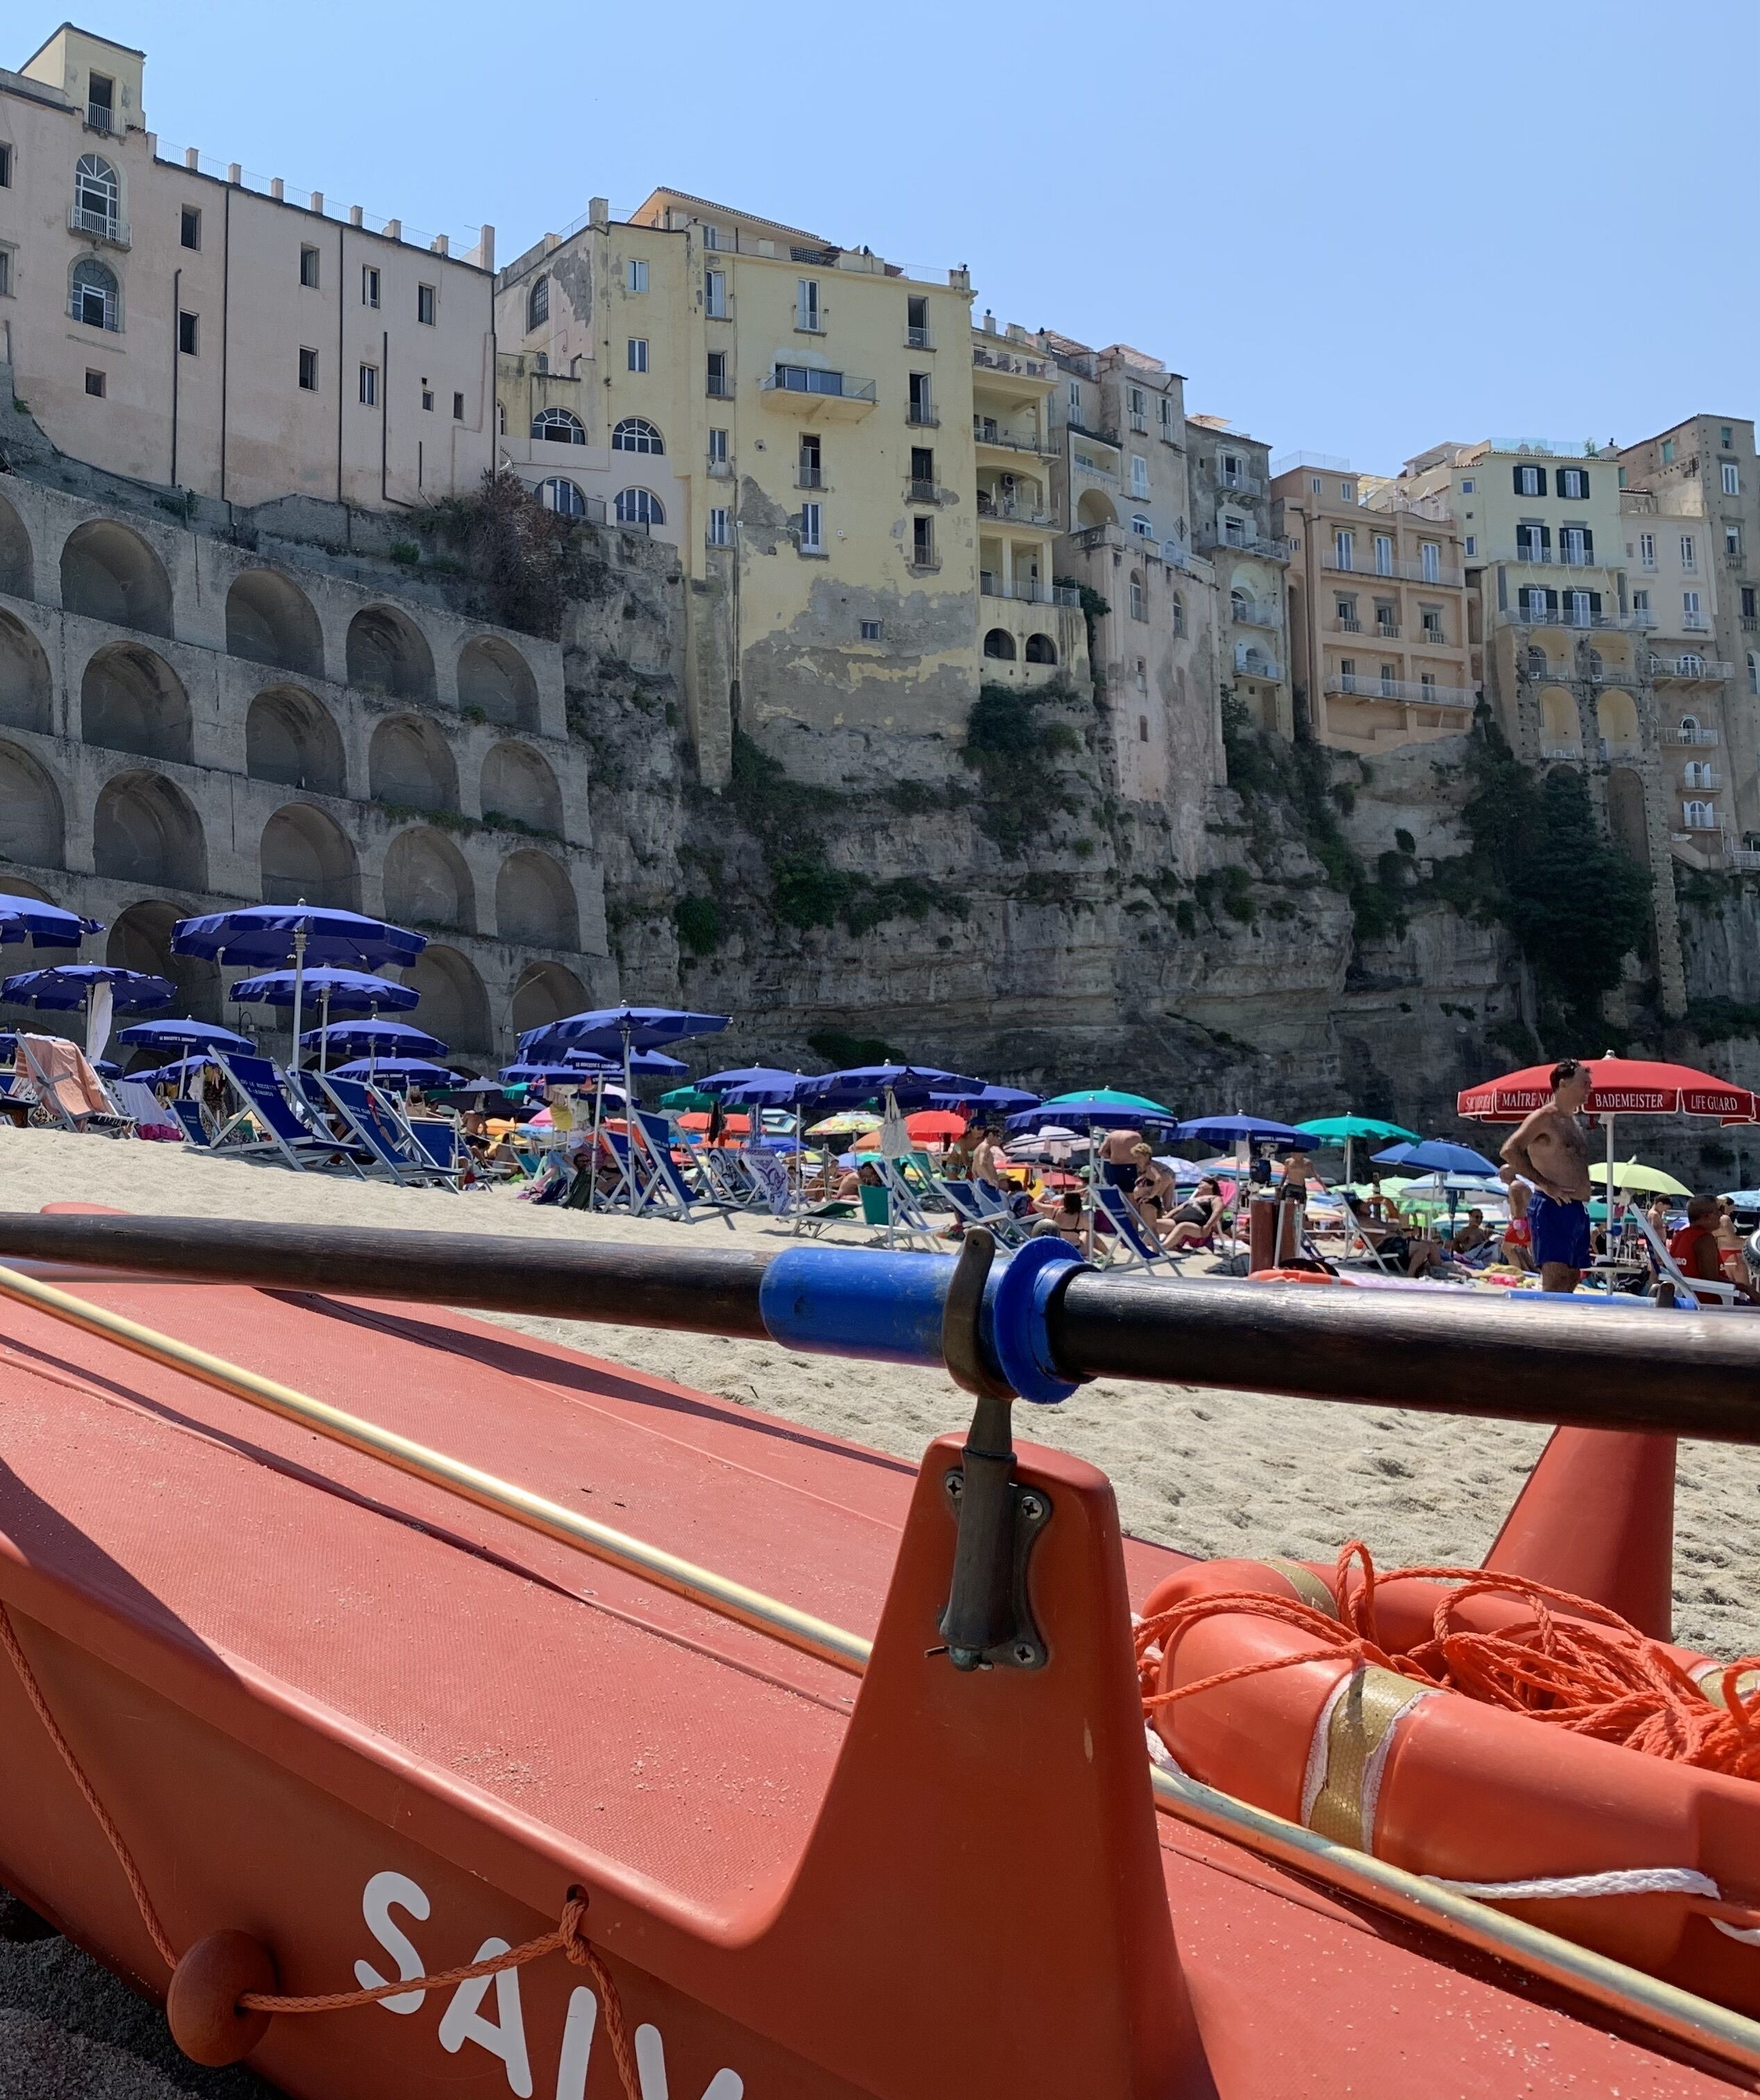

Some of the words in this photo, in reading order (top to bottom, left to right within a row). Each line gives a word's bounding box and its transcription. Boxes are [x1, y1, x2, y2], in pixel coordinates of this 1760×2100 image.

[1595, 1094, 1663, 1108] BADEMEISTER
[1691, 1094, 1706, 1110] LIFE
[1707, 1095, 1738, 1111] GUARD
